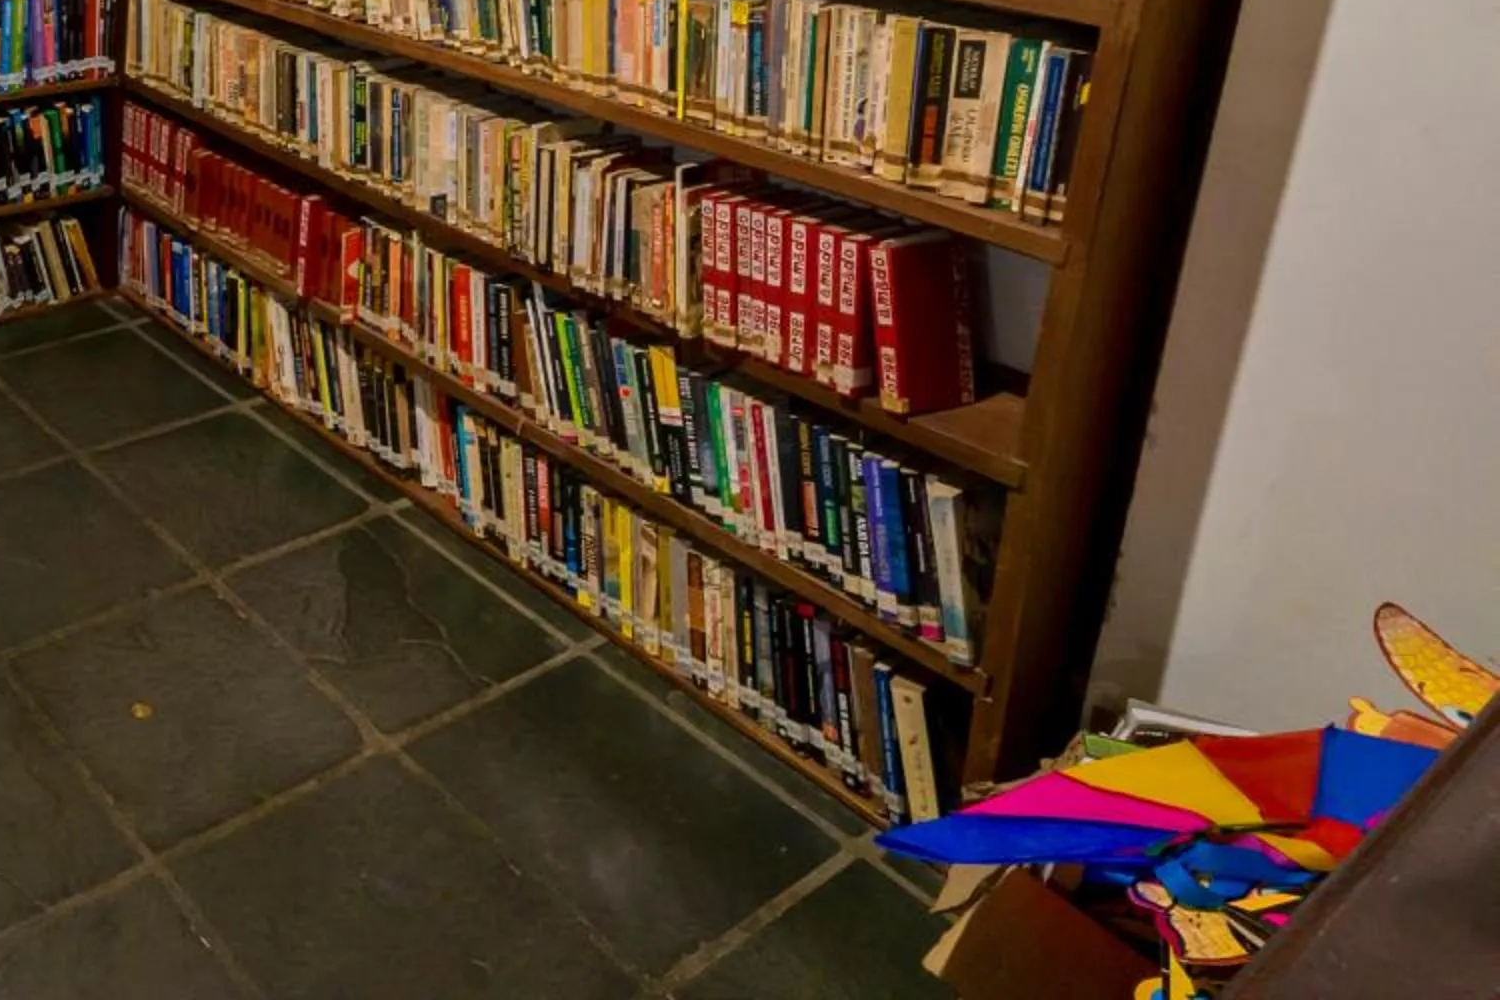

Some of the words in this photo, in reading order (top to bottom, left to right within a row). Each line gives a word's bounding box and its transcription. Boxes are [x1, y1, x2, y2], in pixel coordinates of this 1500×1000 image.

[792, 229, 805, 289] amado
[819, 240, 832, 299] amado
[841, 247, 855, 308] amado
[790, 315, 804, 362] Jorge
